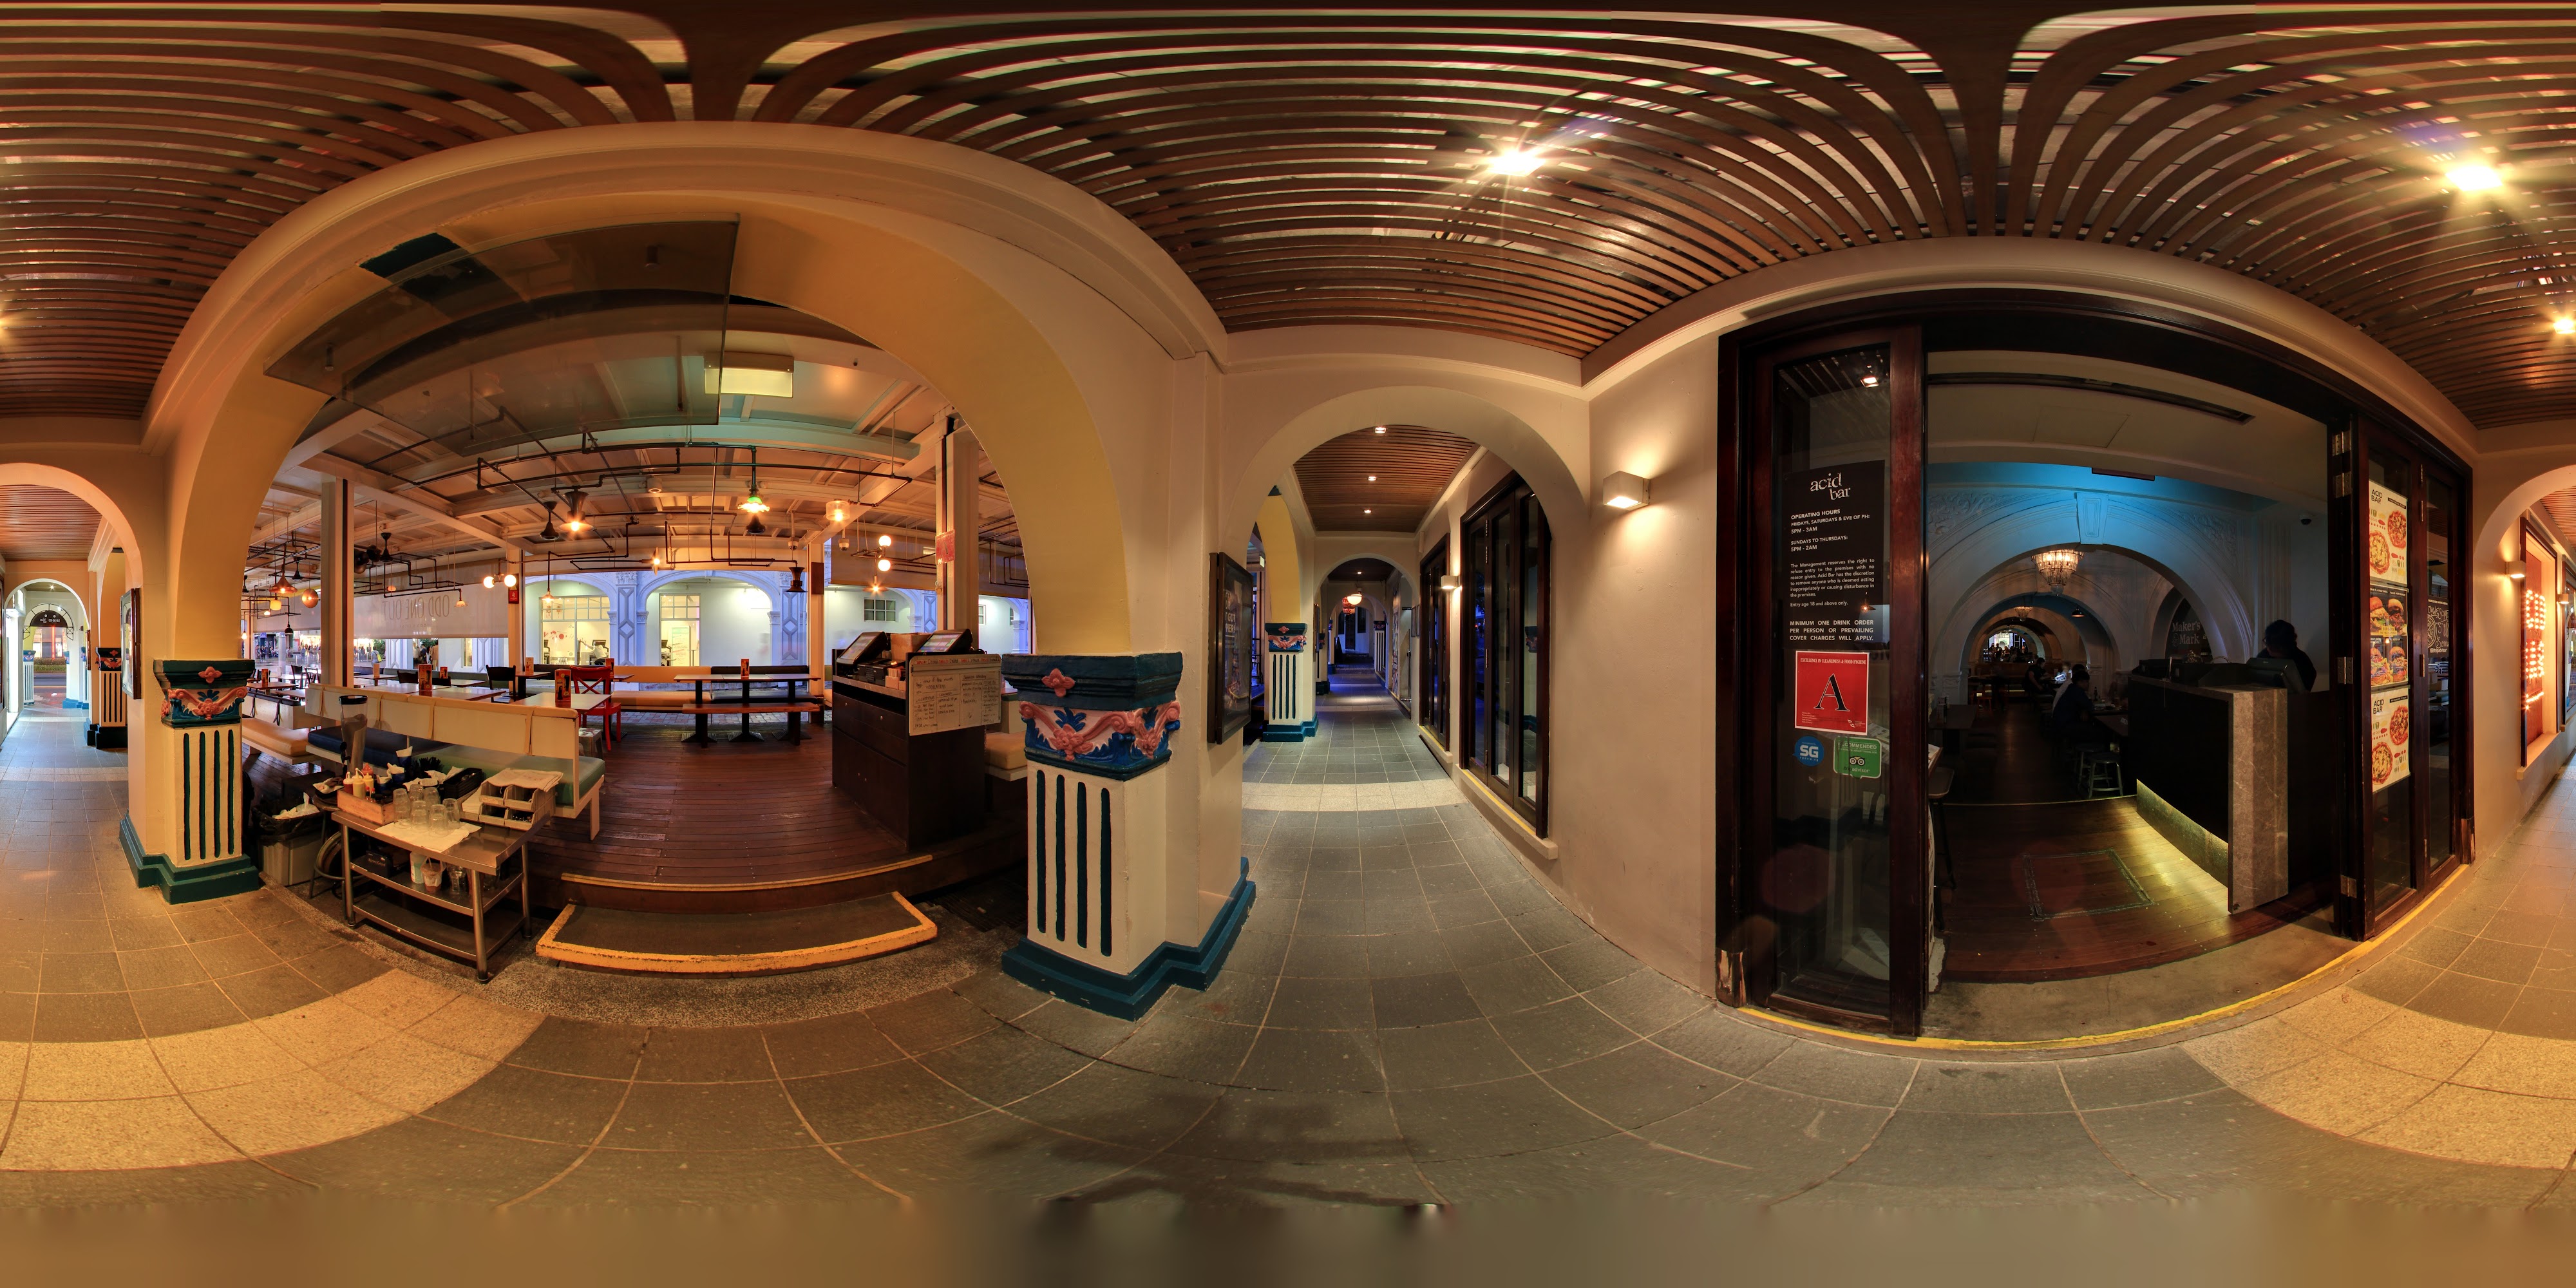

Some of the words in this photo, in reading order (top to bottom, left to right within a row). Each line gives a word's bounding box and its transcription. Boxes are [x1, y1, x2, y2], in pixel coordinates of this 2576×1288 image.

[1810, 472, 1842, 491] acid
[1830, 487, 1851, 500] bar
[2372, 489, 2382, 498] ACID
[2371, 495, 2381, 504] BAR
[1791, 511, 1820, 520] OPERATING
[1226, 624, 1235, 633] PIER!
[2172, 621, 2201, 632] Maker's
[2179, 634, 2199, 644] Mark
[1814, 674, 1850, 712] A
[2374, 699, 2384, 707] ACID
[1800, 744, 1819, 758] SG
